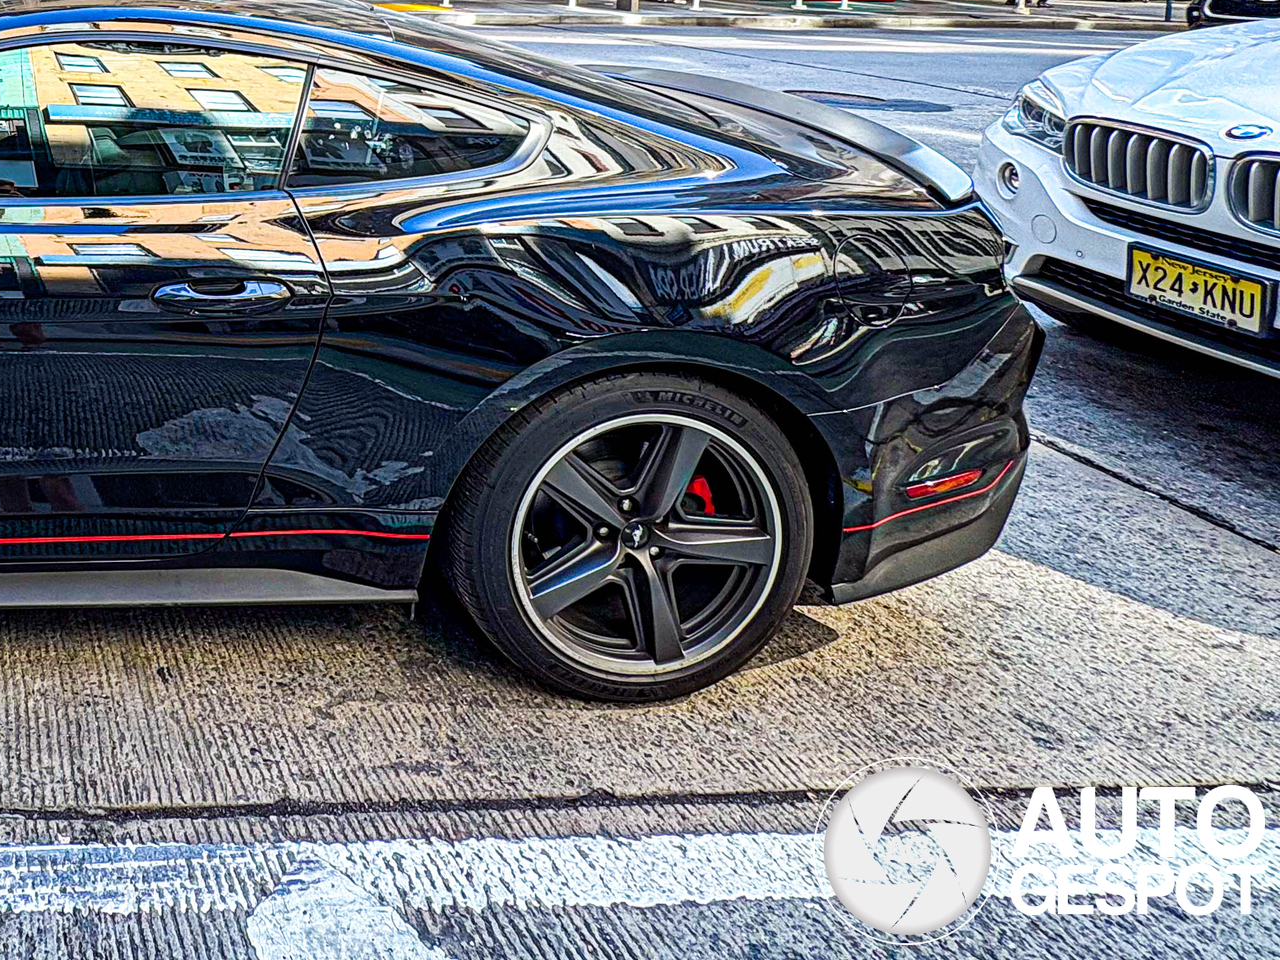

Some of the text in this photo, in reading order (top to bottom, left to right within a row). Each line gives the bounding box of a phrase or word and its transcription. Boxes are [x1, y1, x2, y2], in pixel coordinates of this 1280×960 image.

[1160, 256, 1230, 283] New Jersey
[1158, 294, 1195, 312] Garden
[1198, 306, 1228, 323] State
[657, 392, 744, 425] MICHELIN
